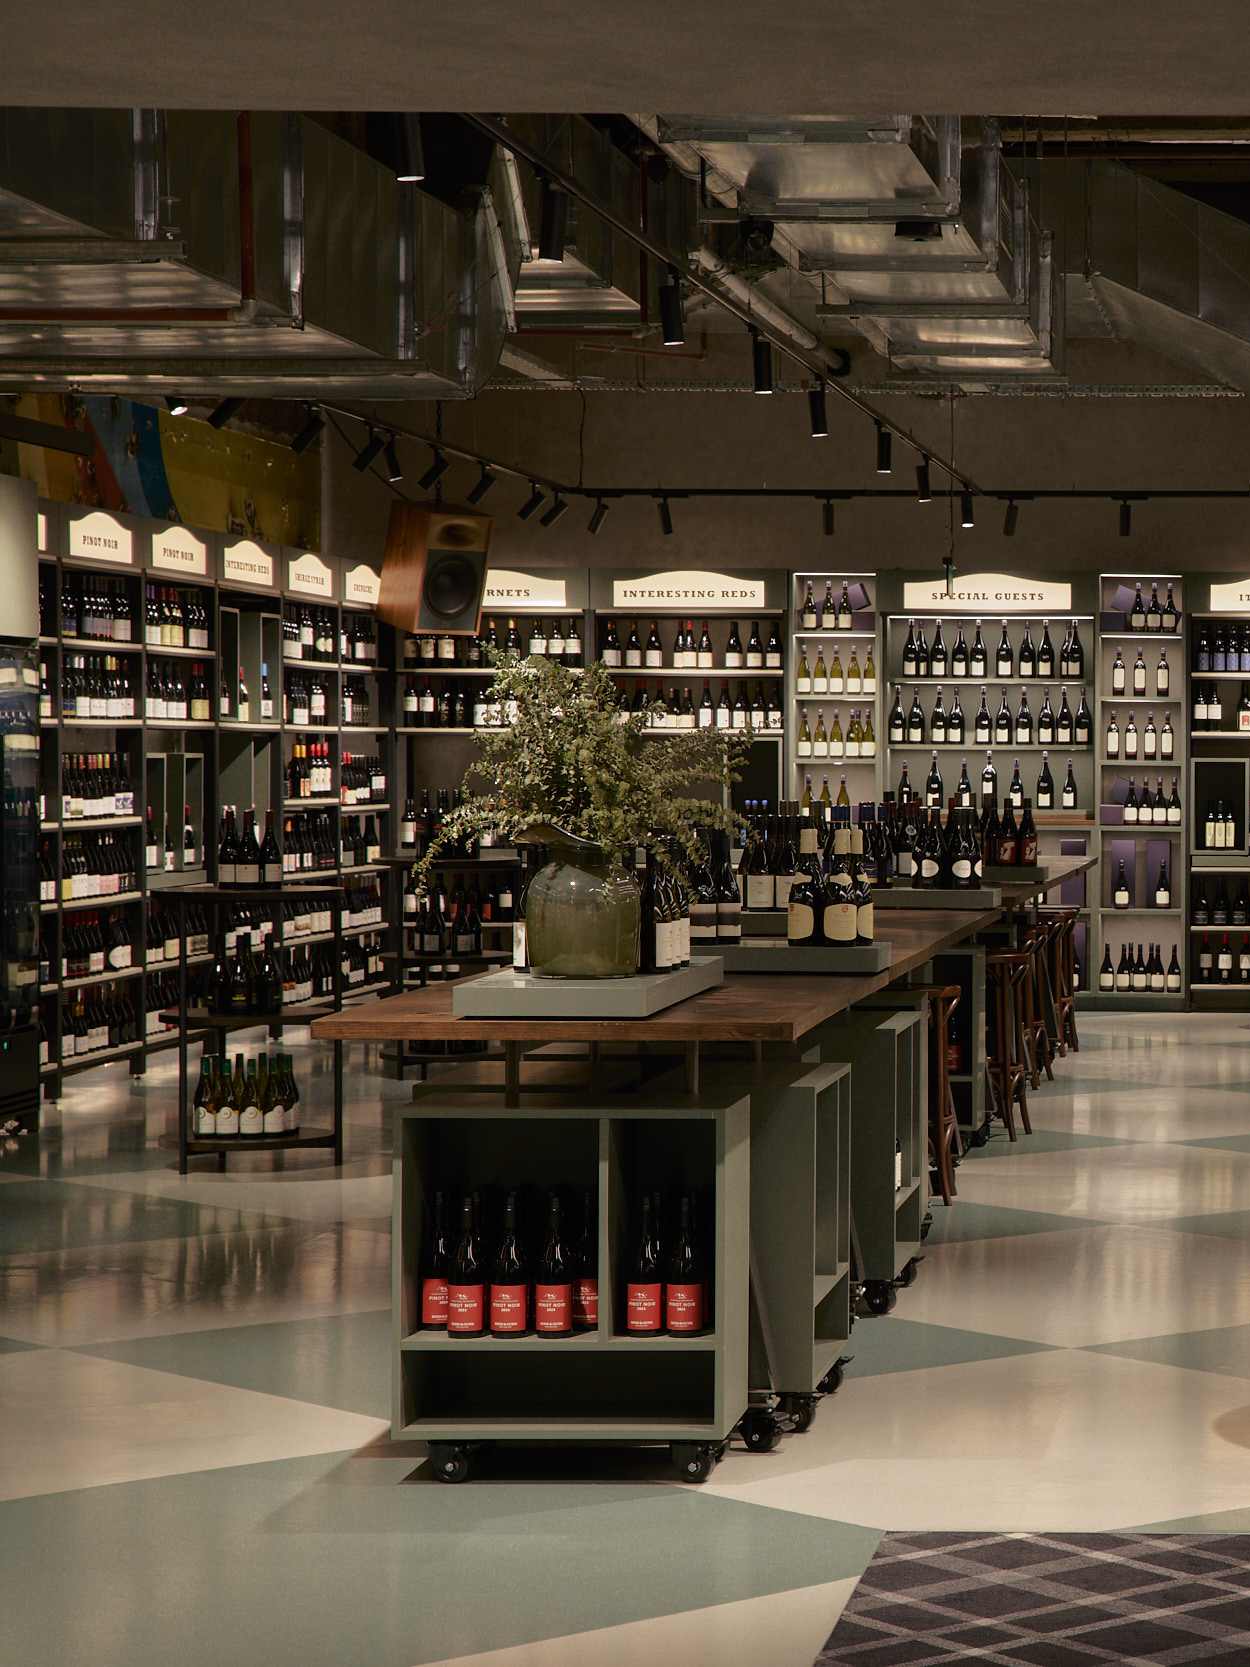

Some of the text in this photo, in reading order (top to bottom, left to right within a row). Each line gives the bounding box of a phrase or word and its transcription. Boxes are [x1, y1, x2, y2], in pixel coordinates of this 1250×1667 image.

[82, 535, 118, 550] PINOT NOIR
[163, 547, 194, 562] PINOT NOIR
[225, 559, 270, 575] INTERESTING REDS
[353, 583, 373, 594] GRENACHE
[486, 589, 530, 597] RNETS
[623, 590, 756, 598] INTERESTING REDS
[931, 592, 1044, 600] SPECIAL GUESTS
